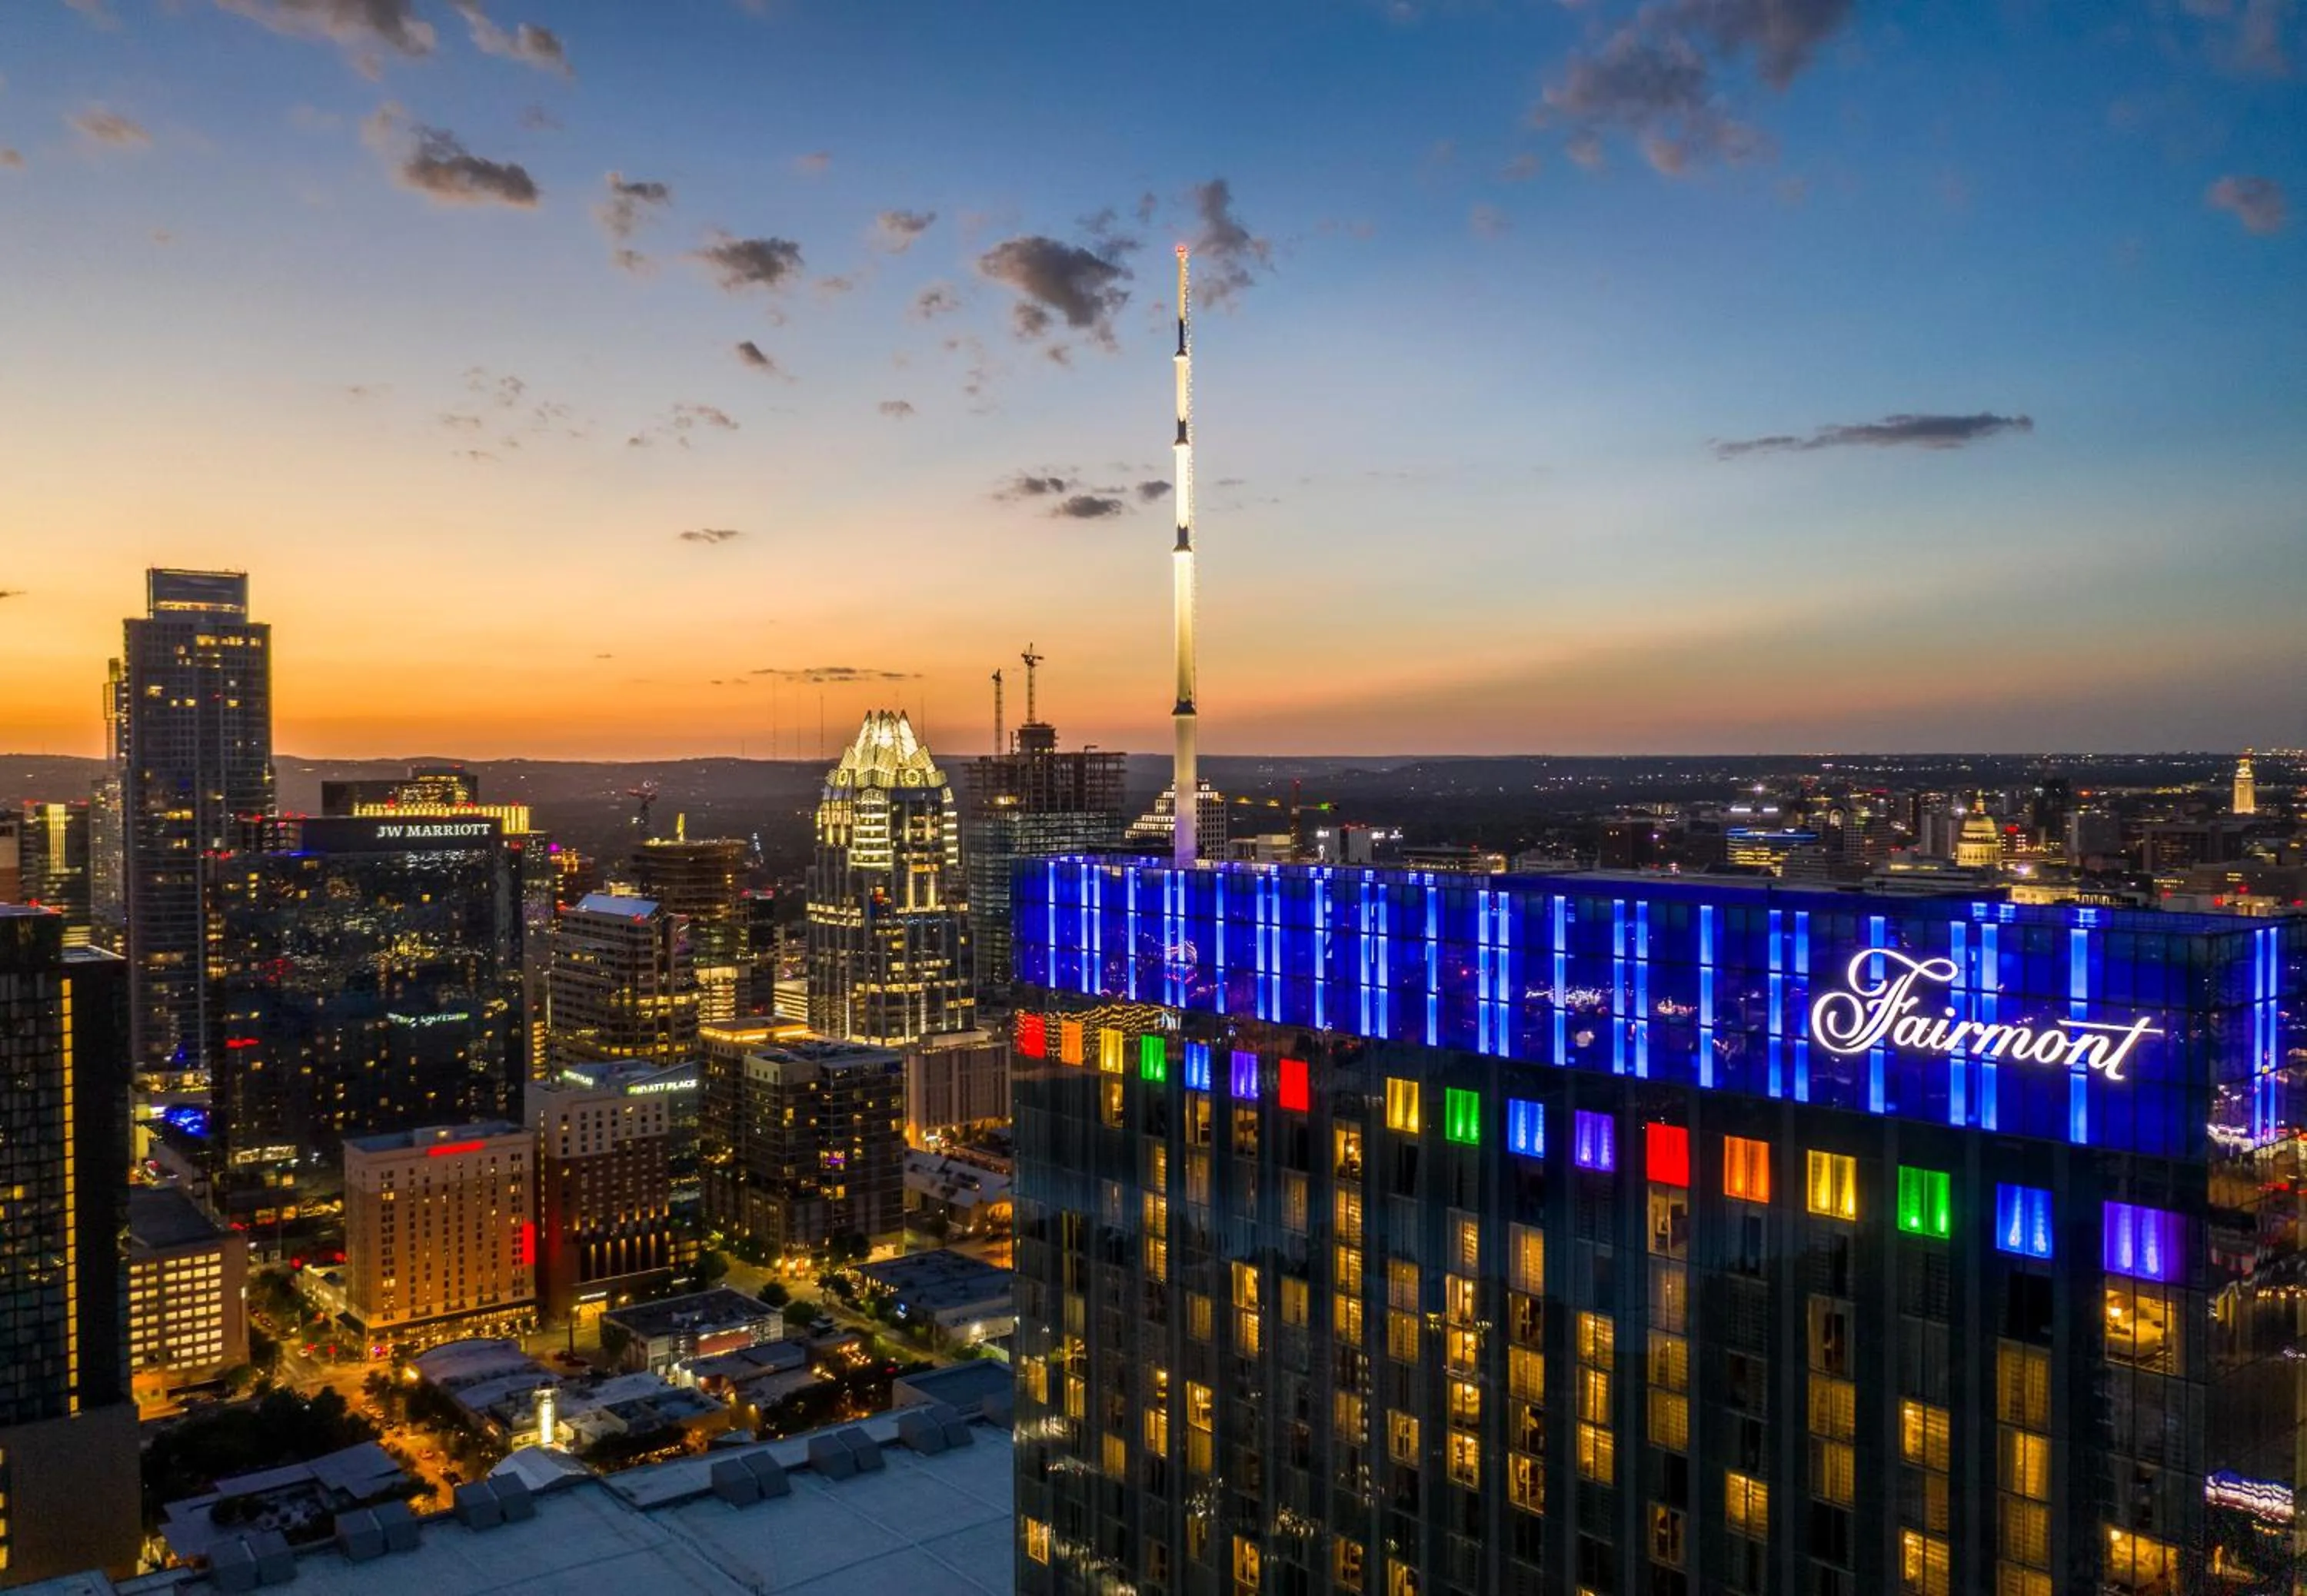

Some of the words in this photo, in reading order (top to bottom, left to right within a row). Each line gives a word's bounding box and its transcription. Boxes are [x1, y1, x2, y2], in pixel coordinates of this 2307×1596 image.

[377, 825, 403, 838] JW
[406, 823, 491, 837] MARRIOTT
[1811, 947, 2165, 1080] Fairmont
